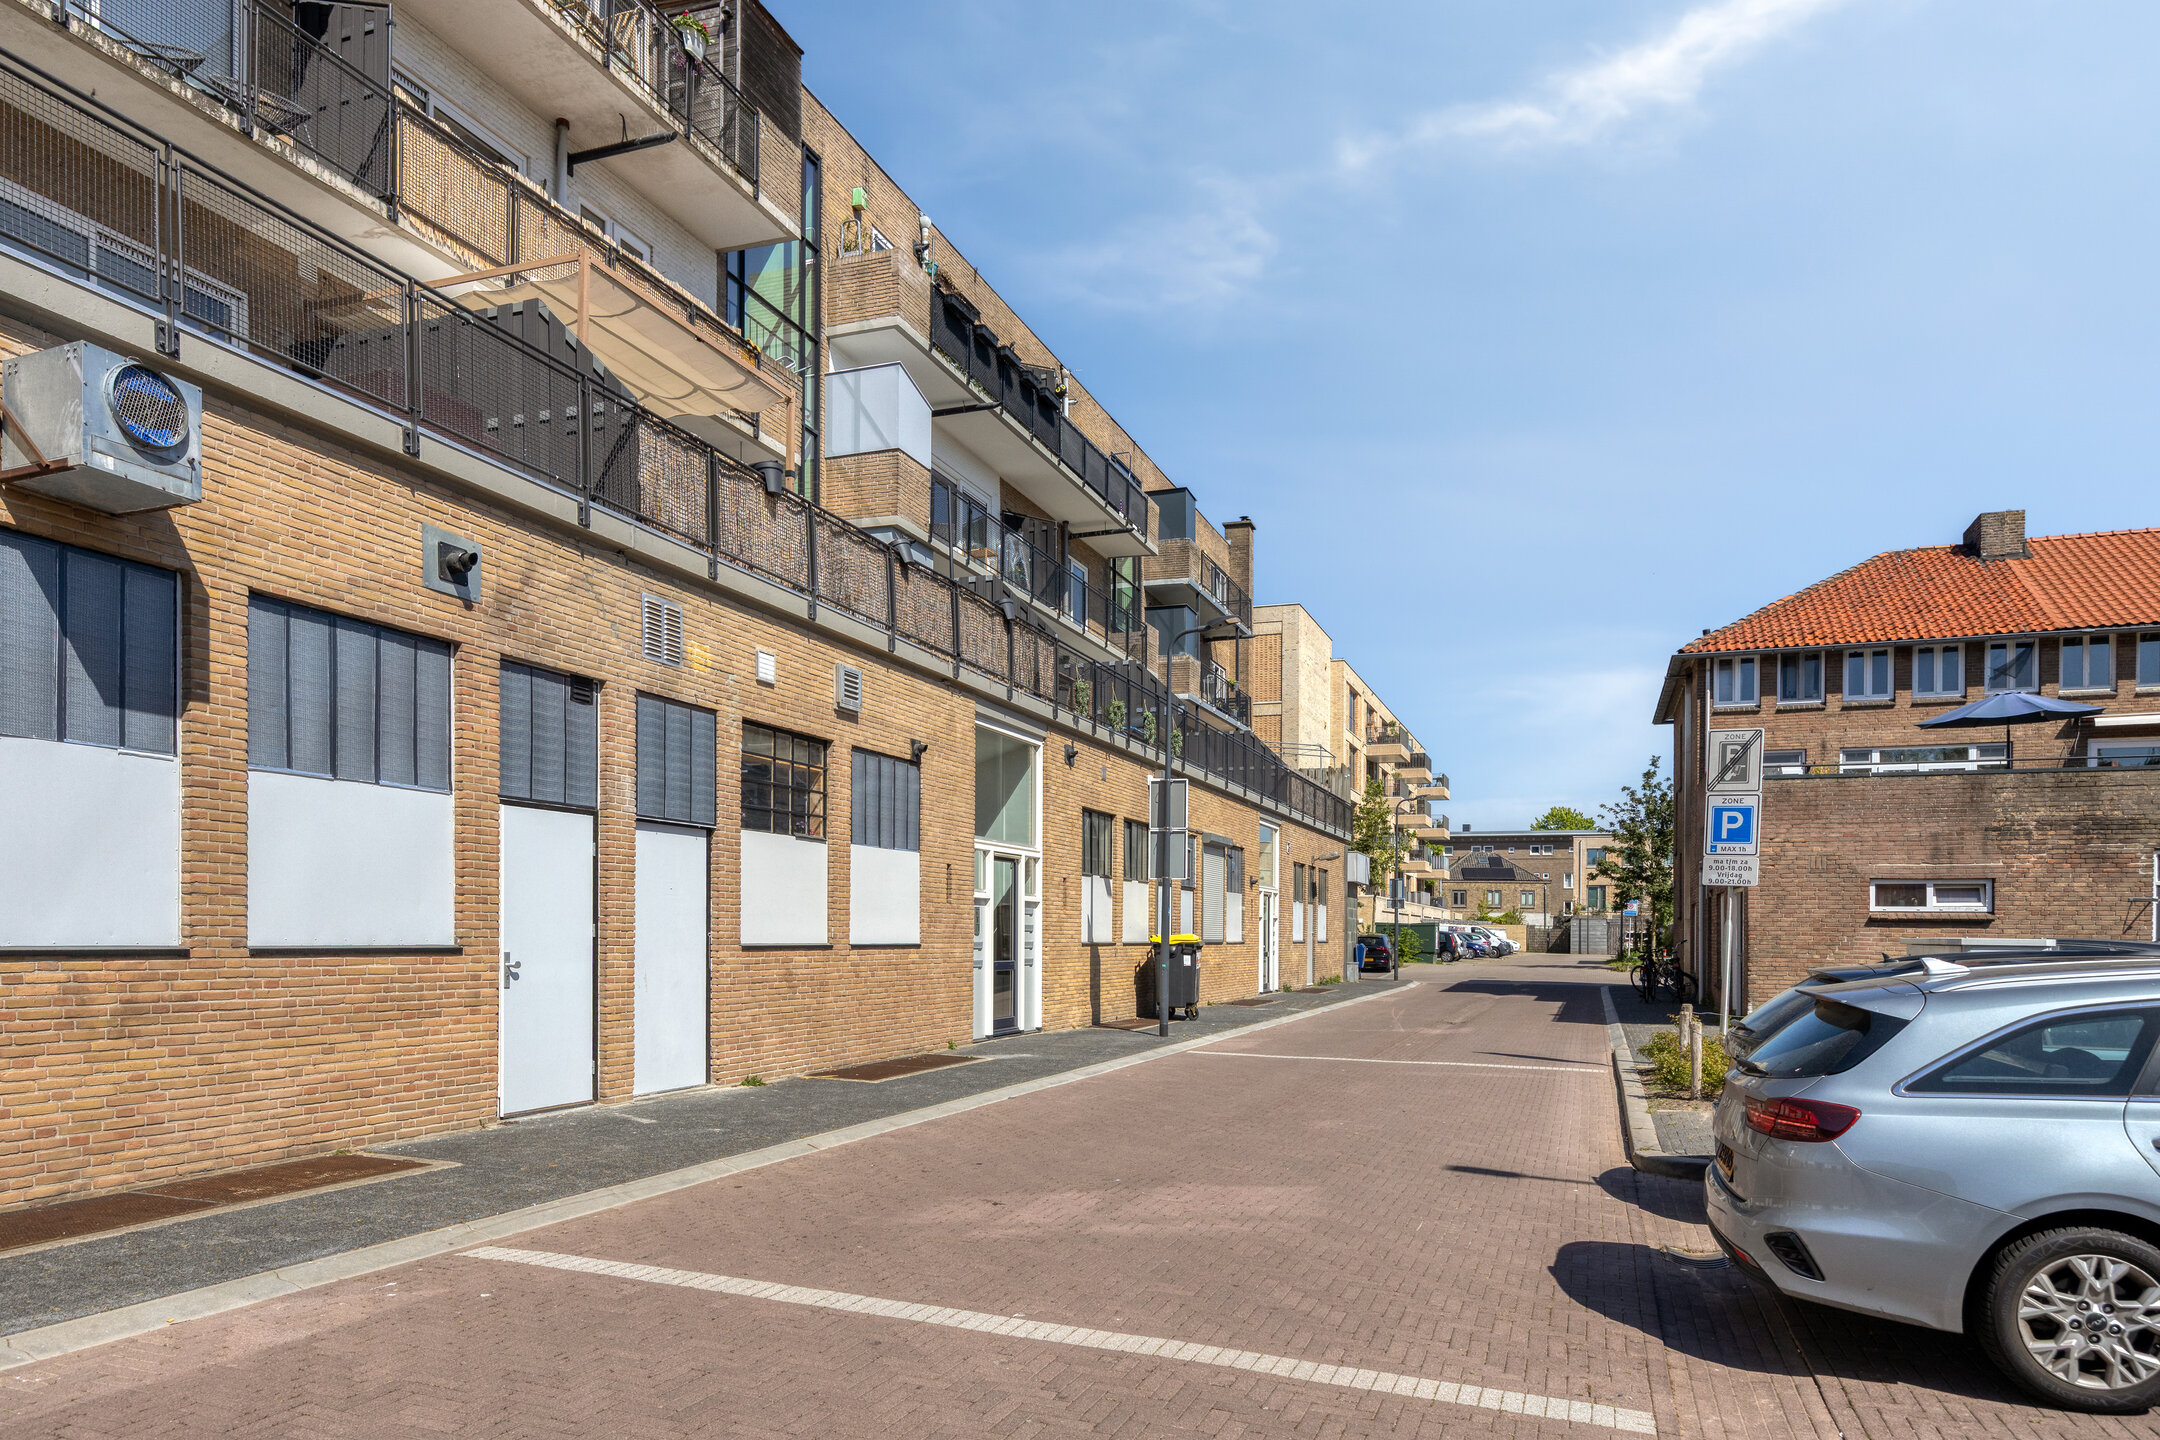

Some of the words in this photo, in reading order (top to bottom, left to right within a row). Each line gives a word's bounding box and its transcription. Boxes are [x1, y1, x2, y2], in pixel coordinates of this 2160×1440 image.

[1721, 811, 1744, 839] P
[1725, 858, 1738, 866] t/m
[1716, 871, 1743, 879] Vrijdag
